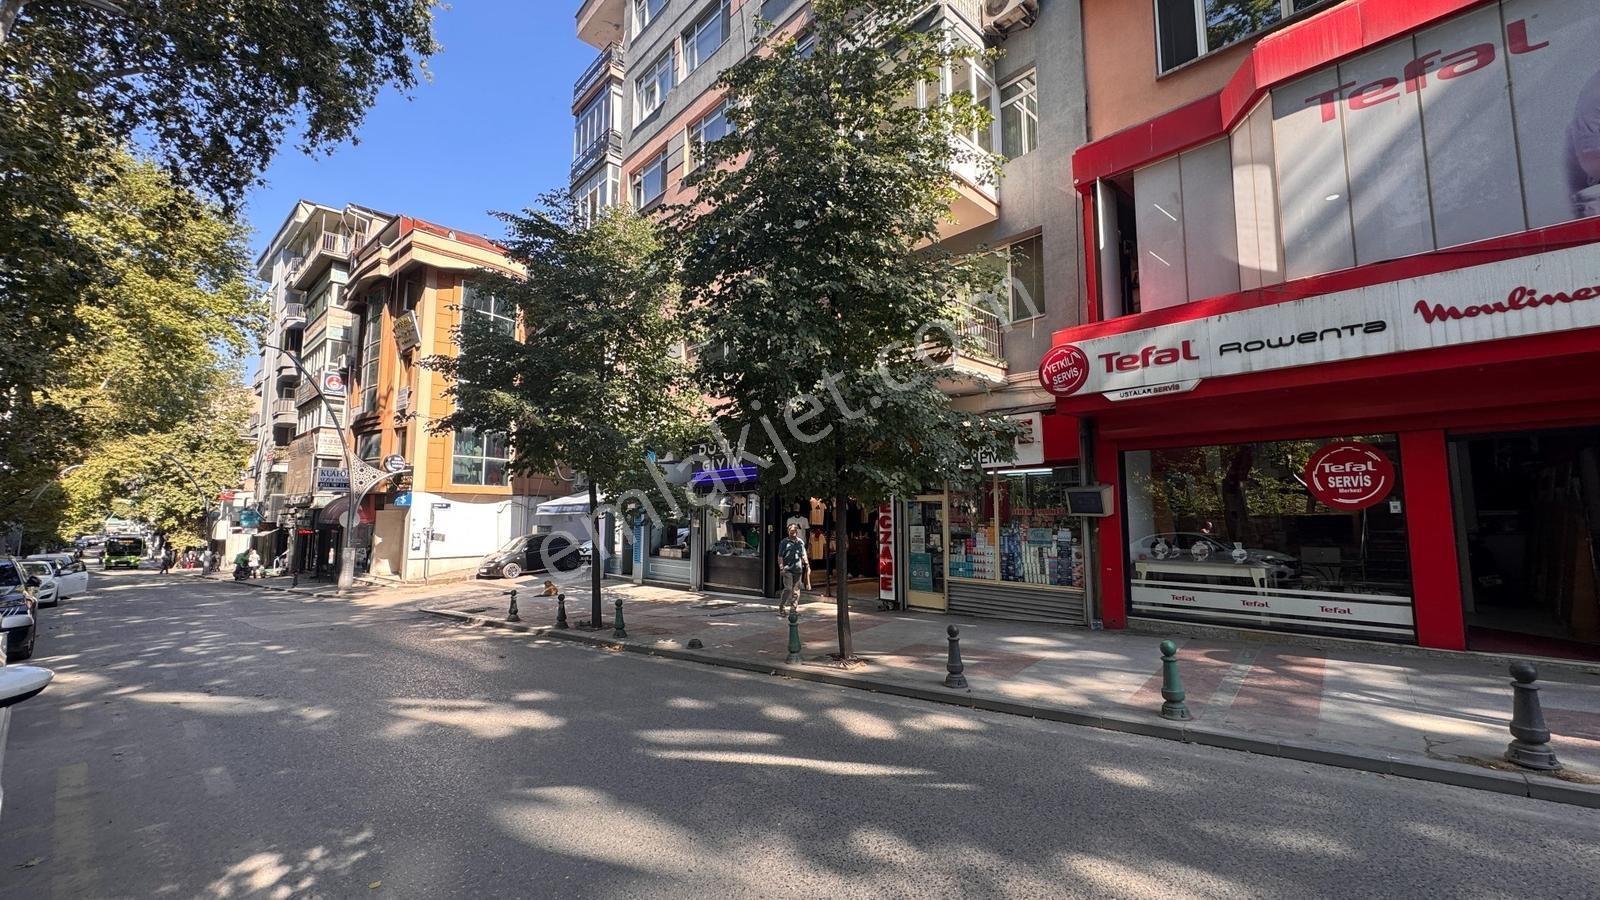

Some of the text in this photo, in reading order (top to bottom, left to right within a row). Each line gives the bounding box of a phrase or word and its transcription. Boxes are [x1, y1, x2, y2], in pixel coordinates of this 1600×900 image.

[1305, 19, 1549, 123] Tefal
[1098, 340, 1200, 373] Tefal
[1052, 366, 1079, 385] SERVİS
[1321, 461, 1376, 473] Tefal
[1328, 472, 1372, 488] SERVİS
[878, 502, 893, 592] ECZANE
[1171, 594, 1196, 602] Tefal
[1240, 600, 1270, 609] Tefal
[1319, 605, 1353, 615] Tefal
